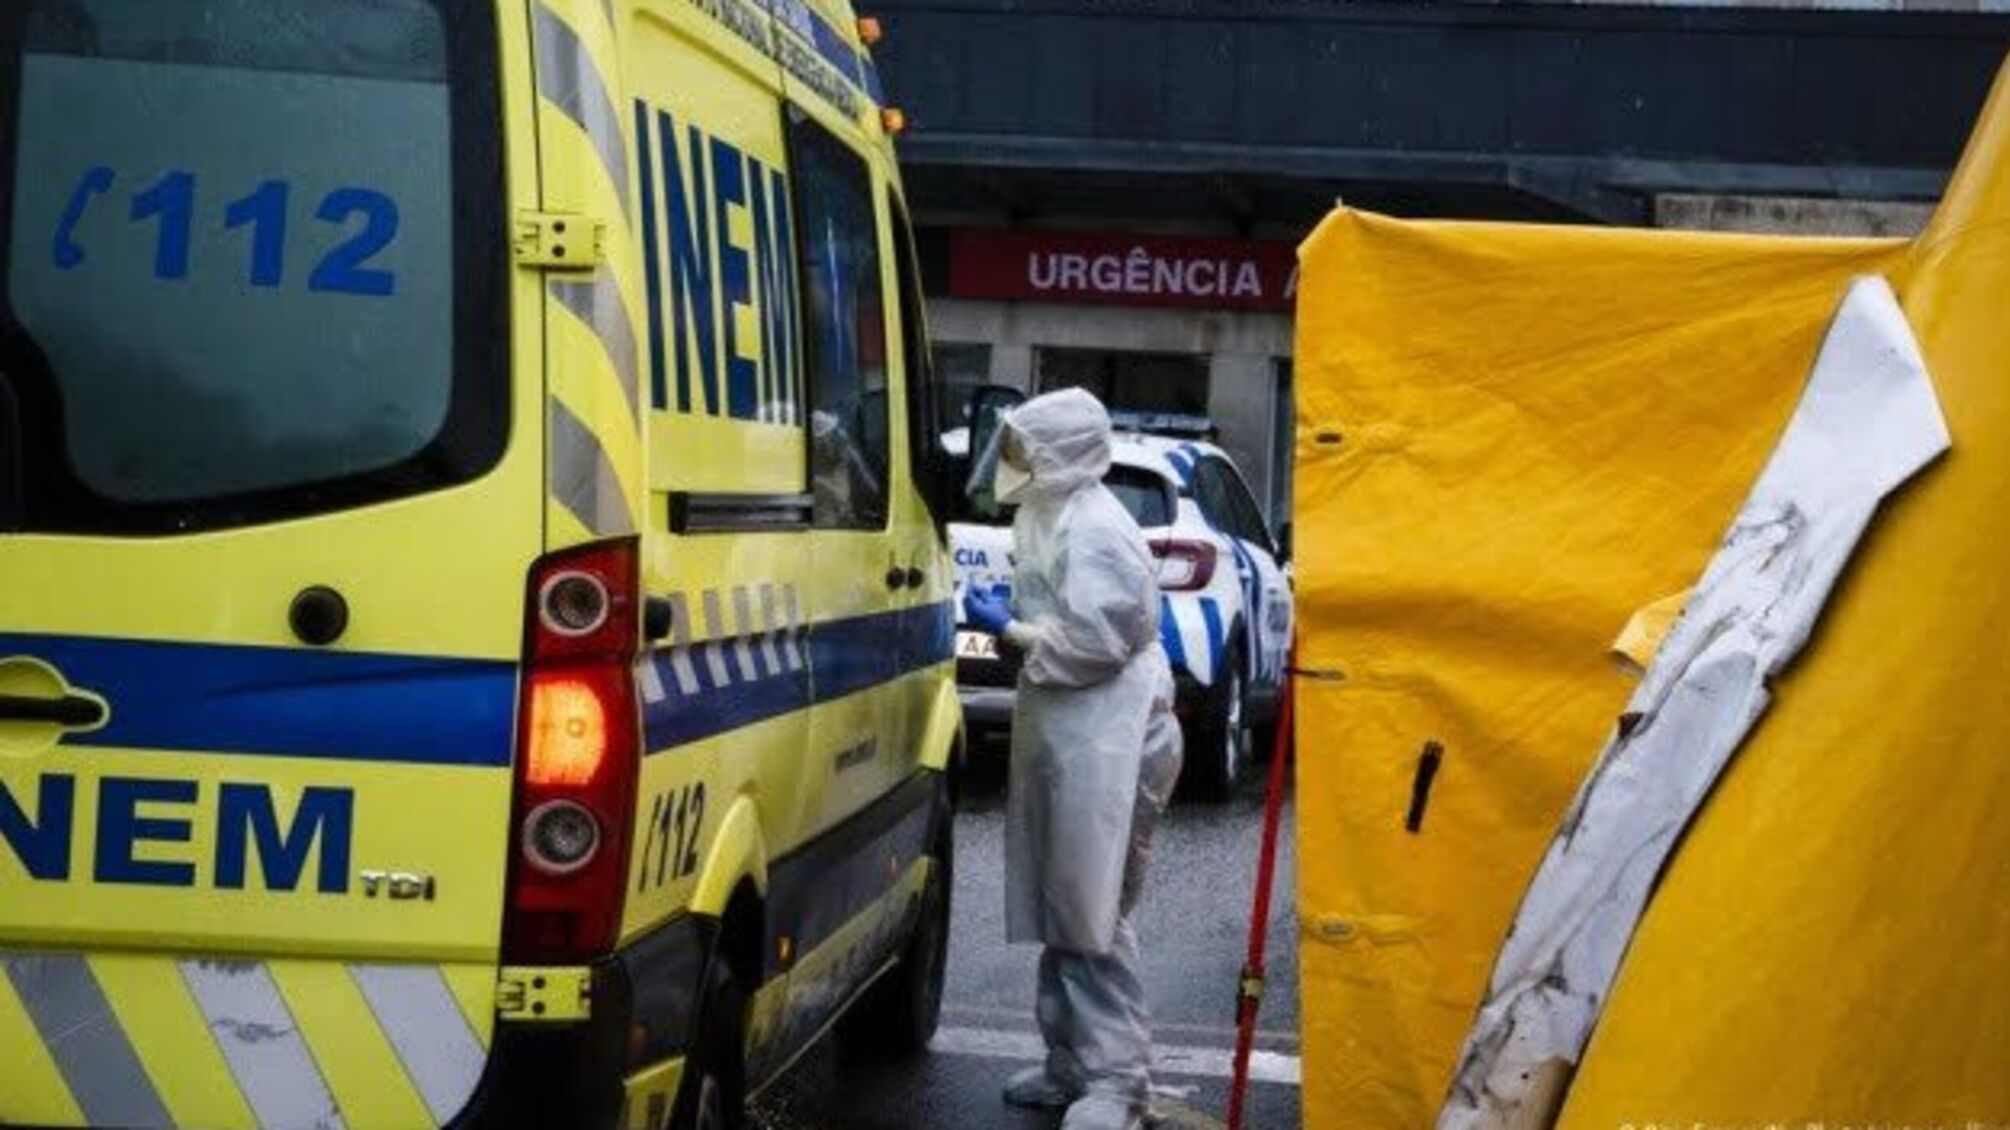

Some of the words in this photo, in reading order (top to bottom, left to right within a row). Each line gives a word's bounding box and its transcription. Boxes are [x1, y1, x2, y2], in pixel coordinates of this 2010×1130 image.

[129, 170, 399, 296] 112
[634, 98, 802, 427] INEM
[1028, 246, 1262, 297] URGÊNCIA
[360, 870, 436, 901] TDI
